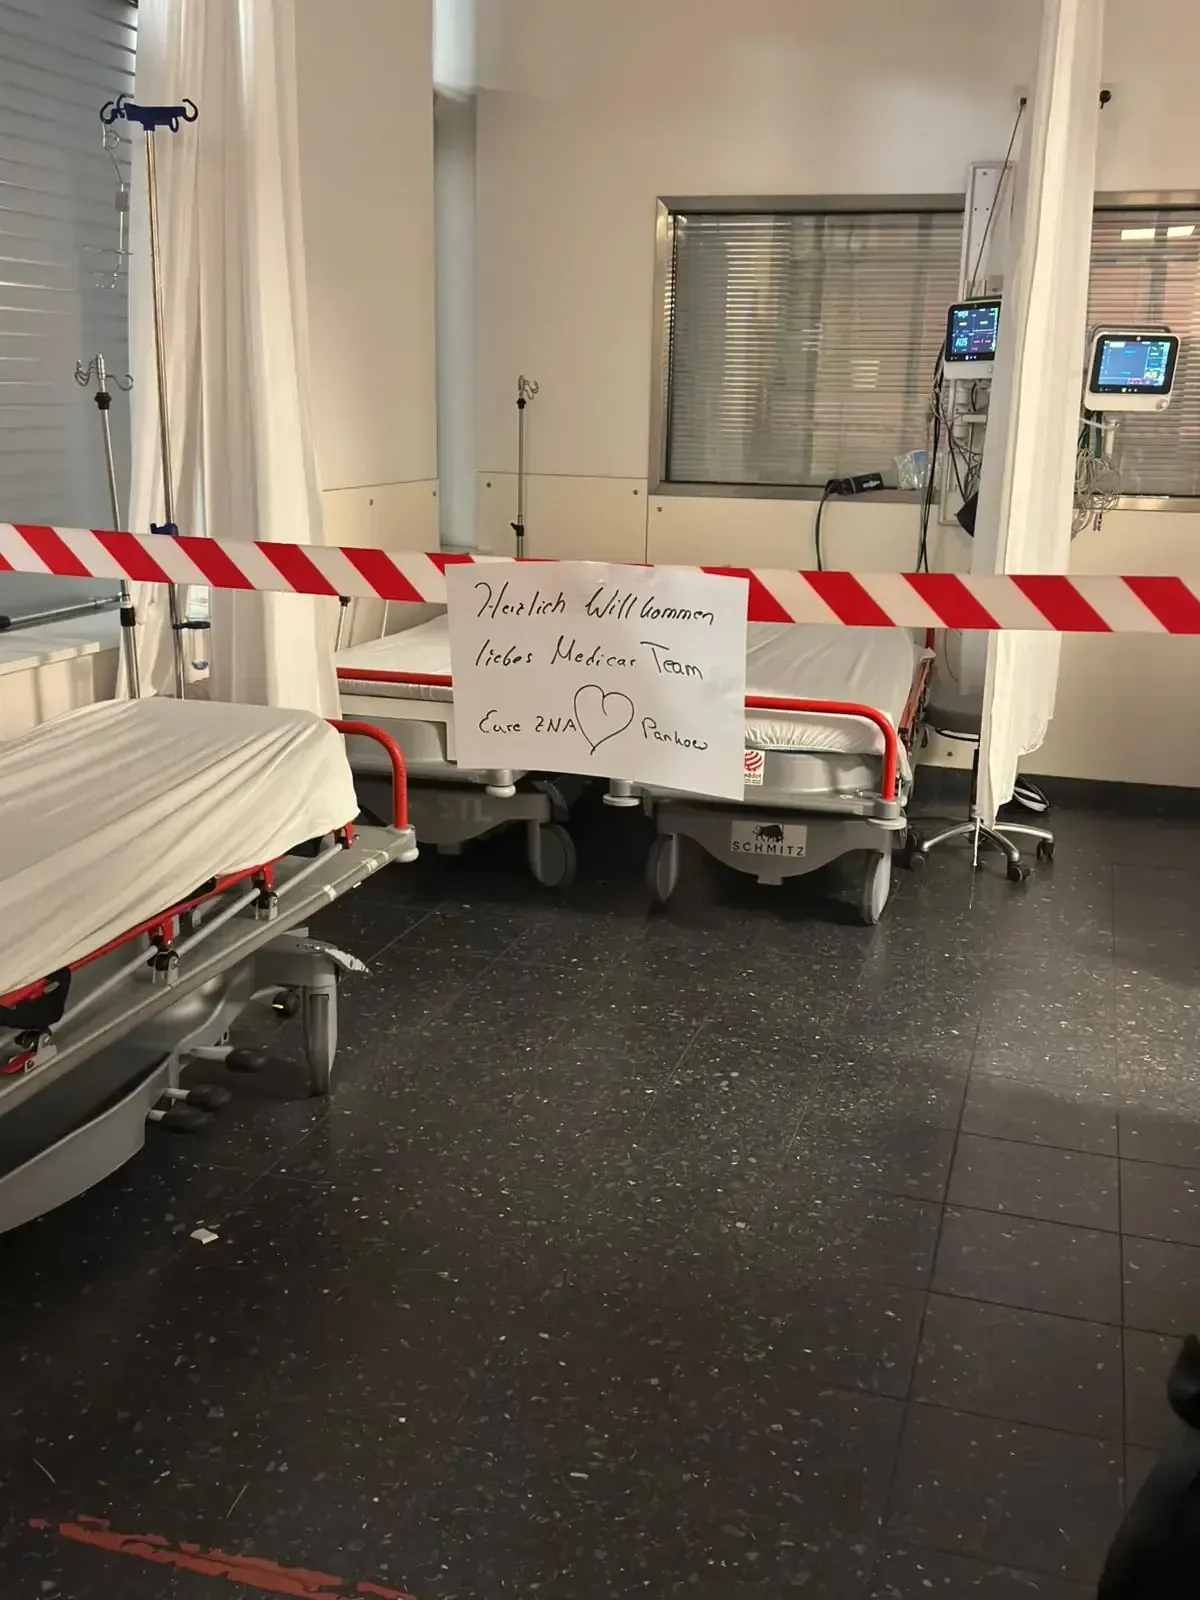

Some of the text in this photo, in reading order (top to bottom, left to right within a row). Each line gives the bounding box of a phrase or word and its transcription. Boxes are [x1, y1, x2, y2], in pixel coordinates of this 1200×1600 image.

[474, 581, 566, 619] Herzlich
[475, 635, 704, 680] liebes Medicar Team
[479, 710, 708, 751] Eure ZNA Pankow
[732, 841, 805, 856] SCHMITZ
